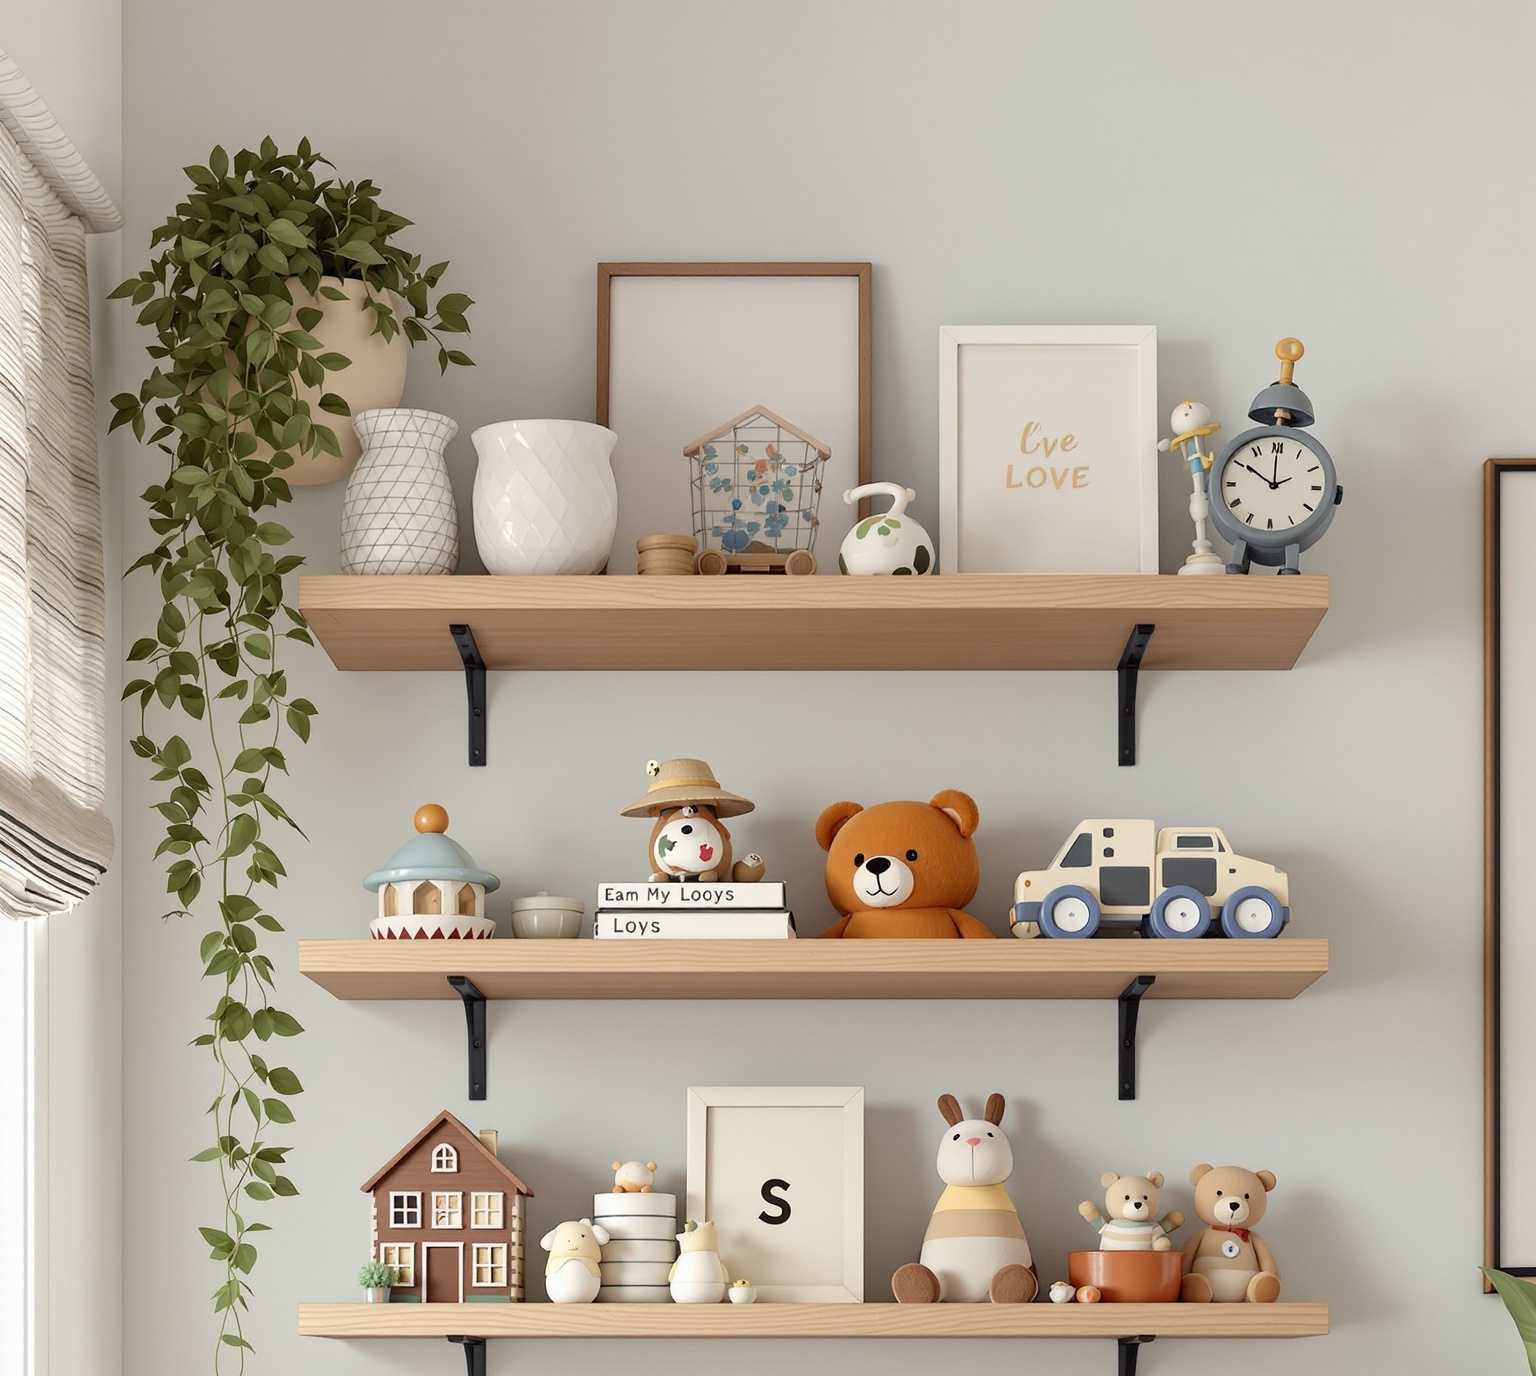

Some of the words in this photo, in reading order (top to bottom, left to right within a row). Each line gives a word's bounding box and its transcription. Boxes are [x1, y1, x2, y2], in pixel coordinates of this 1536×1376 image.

[1006, 464, 1090, 490] LOVE
[605, 888, 638, 901] Eam
[647, 887, 670, 904] My
[680, 887, 734, 904] Looys
[613, 918, 660, 934] Loys
[758, 1178, 791, 1225] S
